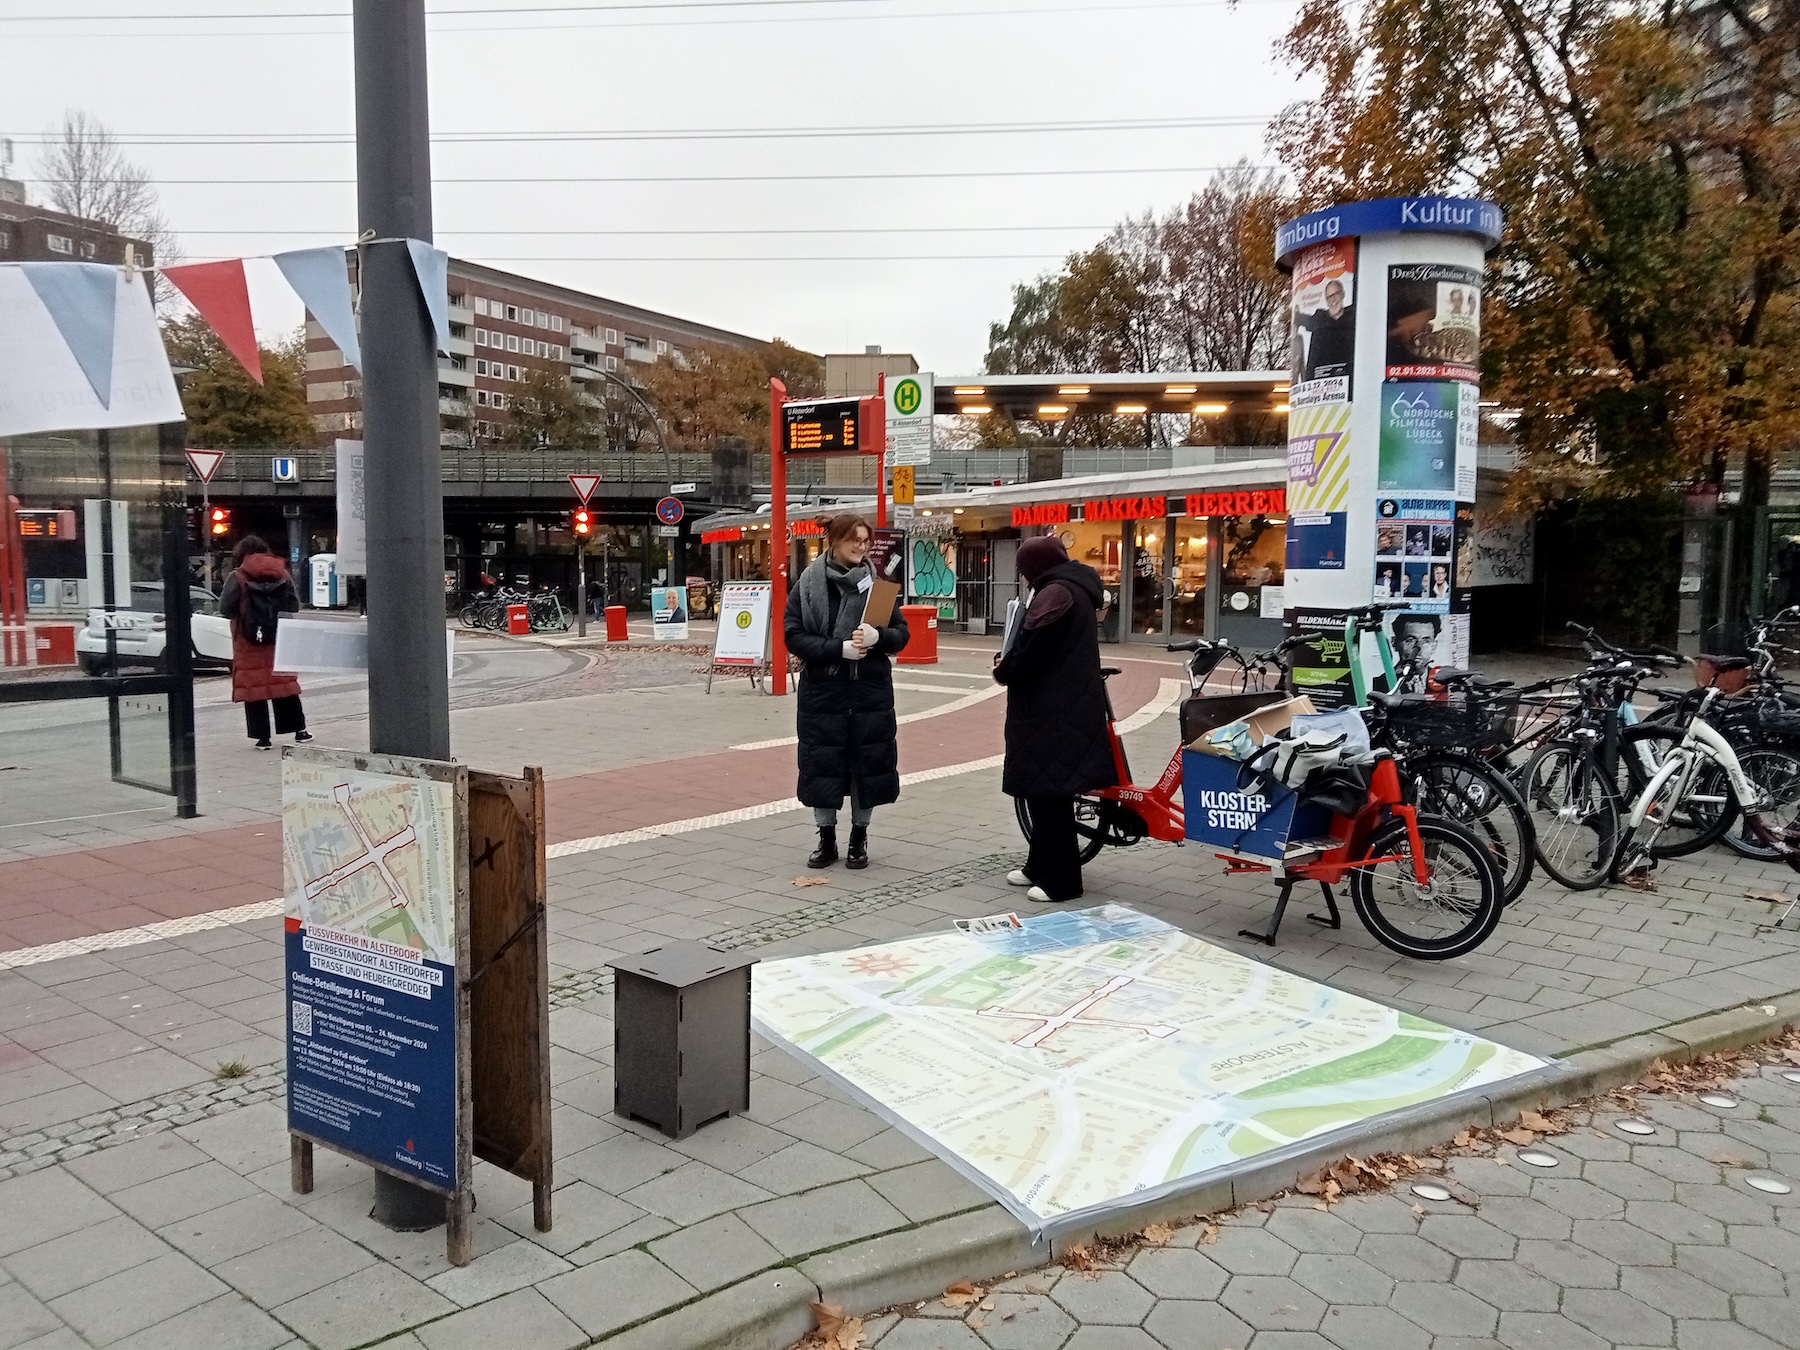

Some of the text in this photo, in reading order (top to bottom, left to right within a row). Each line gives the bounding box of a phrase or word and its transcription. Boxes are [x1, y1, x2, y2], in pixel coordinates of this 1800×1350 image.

[1401, 200, 1474, 225] Kultur
[1479, 204, 1493, 230] in
[1389, 366, 1437, 377] 02.01.2025
[901, 386, 914, 408] H
[1389, 418, 1437, 428] FILMTAGE
[1403, 408, 1455, 420] NORDISCHE
[275, 459, 294, 480] U
[1011, 503, 1070, 526] DAMEN
[1084, 495, 1166, 522] MAKKAS
[1185, 489, 1287, 517] HERREN
[1118, 789, 1144, 802] 39749
[1201, 790, 1271, 813] KLOSTER-
[1208, 810, 1257, 831] STERN
[308, 925, 419, 961] FUSSVERKEHR IN ALSTERDORF
[305, 939, 439, 982] GEWERBESTANDORT ALSTERDORFER
[312, 956, 428, 996] STRASSE UND HEUBERGREDDER
[292, 970, 384, 1006] Online-Beteiligung & Forum
[313, 1007, 354, 1029] Online-Beteiligung
[365, 1024, 373, 1033] 01.
[387, 1030, 412, 1045] November
[412, 1038, 427, 1050] 2024
[308, 1049, 330, 1063] November
[331, 1057, 343, 1067] 2024
[1210, 1040, 1309, 1071] ALSTERDORF
[395, 1150, 422, 1170] Hamburg
